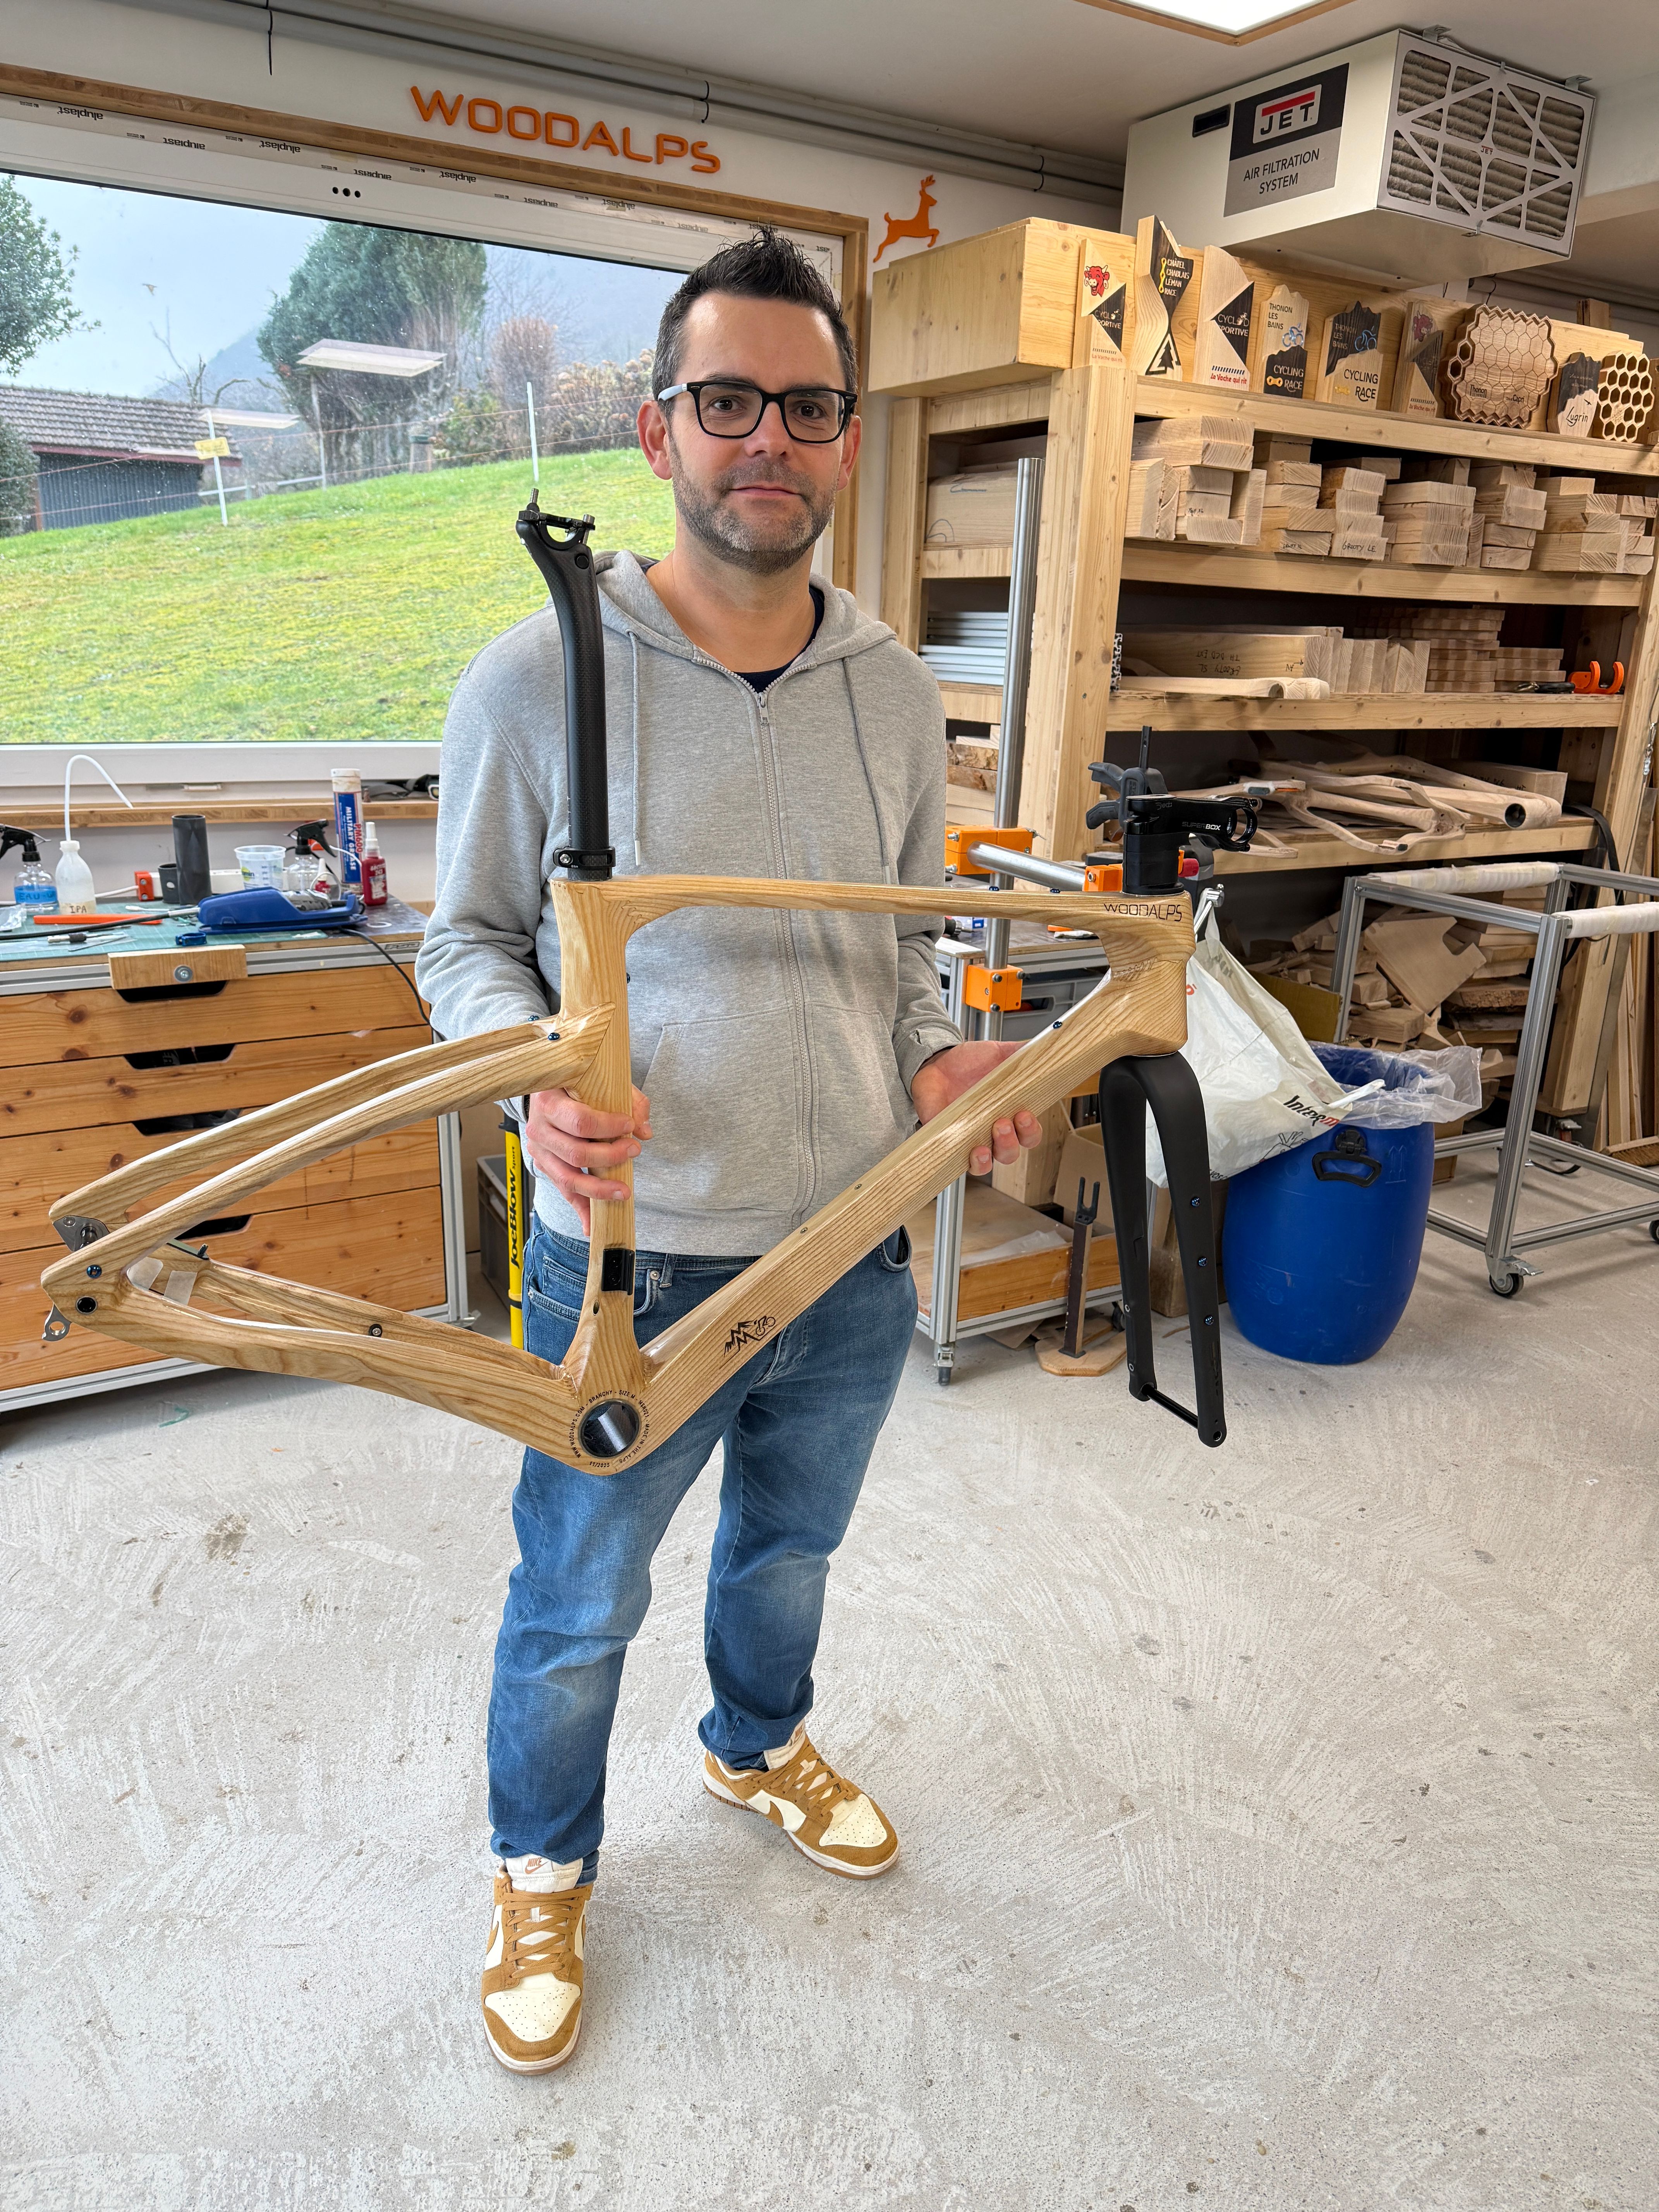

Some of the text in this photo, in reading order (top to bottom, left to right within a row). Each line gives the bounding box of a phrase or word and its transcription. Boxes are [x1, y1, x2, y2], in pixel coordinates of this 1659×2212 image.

[58, 106, 103, 120] aluplast
[1260, 102, 1315, 135] JET
[410, 86, 720, 173] WOODALPS
[259, 141, 301, 153] aluplast
[1243, 148, 1319, 181] AIR FILTRATION
[439, 171, 476, 183] aluplast
[1259, 173, 1298, 194] SYSTEM
[601, 199, 635, 210] aluplast
[1167, 258, 1185, 269] CHÂTEL
[1166, 269, 1190, 279] CHABLAIS
[1165, 276, 1182, 288] LÉMAN
[1164, 288, 1177, 296] RACE
[1269, 303, 1292, 313] THONON
[1267, 321, 1283, 330] BAINS
[1335, 323, 1357, 334] THONON
[1333, 341, 1348, 349] BAINS
[1274, 364, 1304, 377] CYCLING
[1344, 369, 1378, 384] CYCLING
[1284, 380, 1303, 392] RACE
[1470, 384, 1487, 398] Thonon
[1355, 386, 1376, 402] RACE
[1513, 394, 1525, 404] Capri
[1566, 407, 1588, 427] Lugrin
[1342, 541, 1364, 552] GROOTY
[345, 806, 354, 841] MILITARY
[354, 823, 363, 853] PM600
[69, 905, 87, 914] IPA
[1104, 903, 1182, 922] WOODALPS
[509, 1168, 520, 1269] JoeBlow
[589, 1390, 612, 1403] BRANCHY
[569, 1406, 585, 1458] WWW.WOODALPS.COM
[619, 1455, 631, 1463] ALPS
[527, 1857, 543, 1867] NIKE
